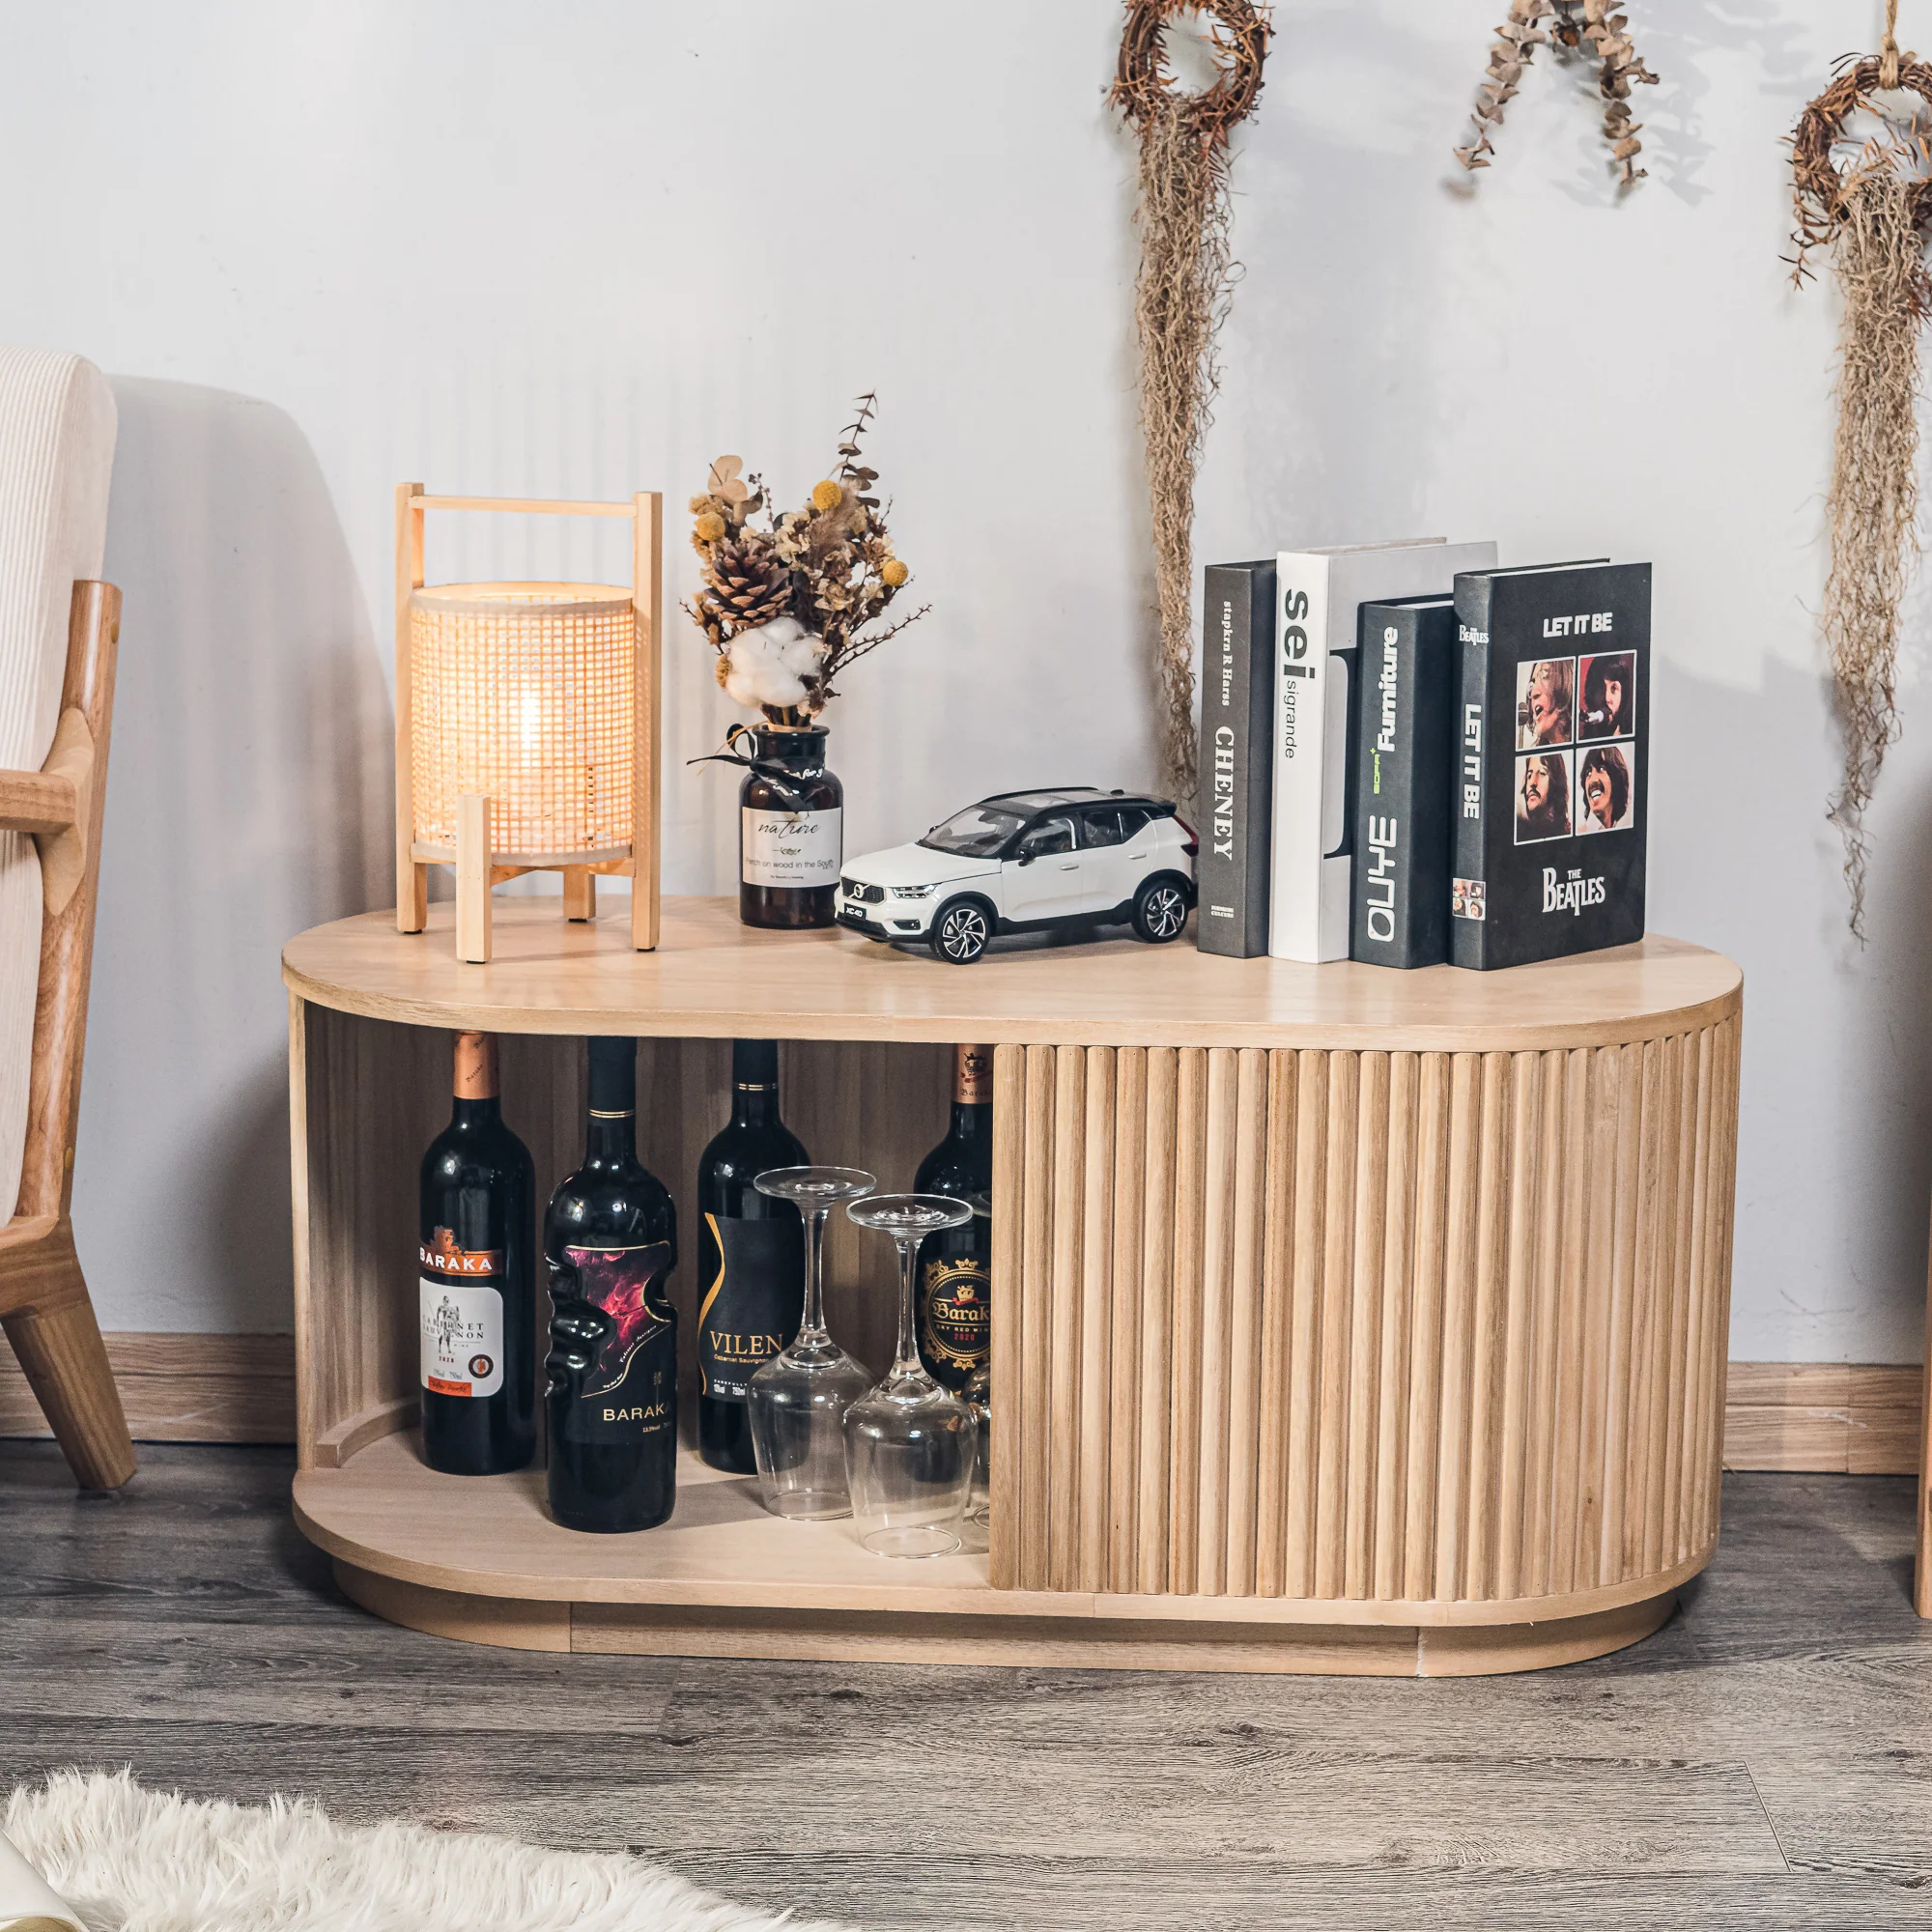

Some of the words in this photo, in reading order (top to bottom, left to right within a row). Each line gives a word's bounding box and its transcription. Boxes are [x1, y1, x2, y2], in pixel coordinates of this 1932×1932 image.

[1283, 588, 1316, 679] sei
[1459, 624, 1490, 646] BEATLES
[1543, 615, 1573, 638] LET
[1574, 613, 1590, 635] IT
[1591, 611, 1613, 633] BE
[1222, 654, 1234, 666] R
[1377, 626, 1400, 753] Furniture
[1283, 680, 1299, 759] sigrande
[1464, 703, 1482, 753] LET
[1463, 754, 1481, 781] IT
[1213, 725, 1235, 861] CHENEY
[1463, 783, 1480, 819] BE
[757, 816, 820, 838] nature
[1567, 868, 1582, 880] THE
[1542, 867, 1606, 917] BEATLES
[419, 1246, 493, 1271] BARAKA
